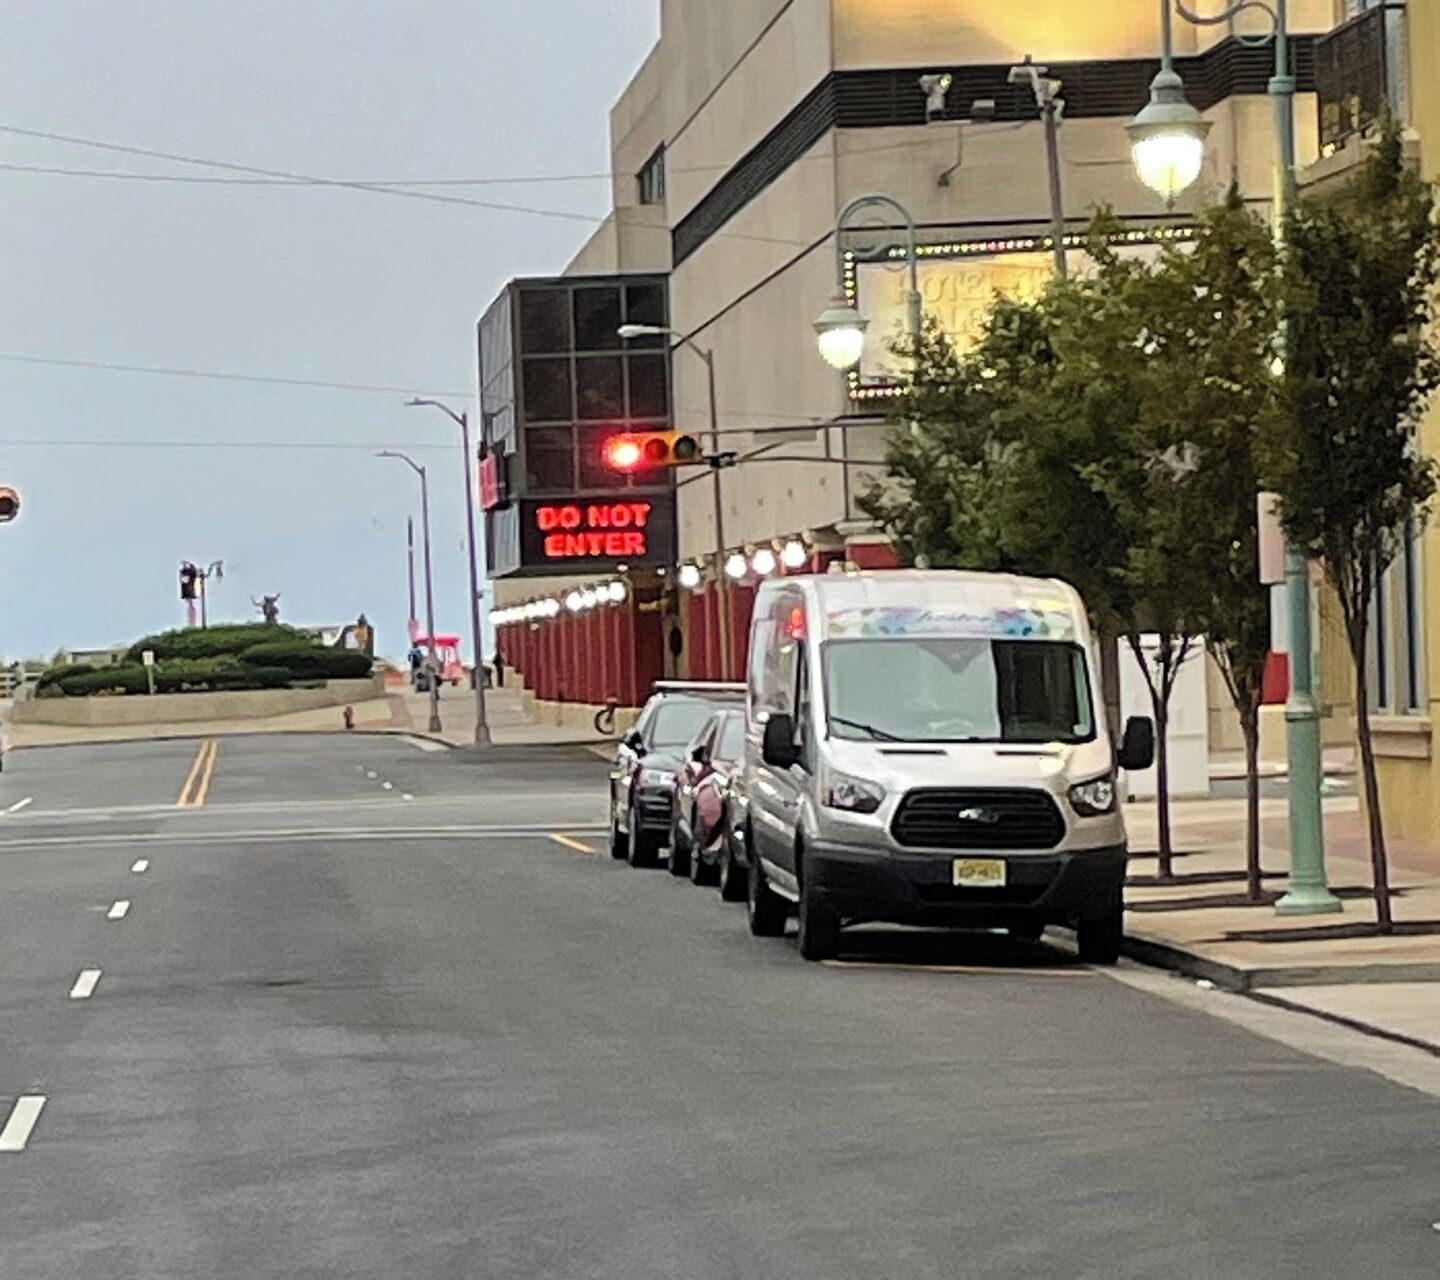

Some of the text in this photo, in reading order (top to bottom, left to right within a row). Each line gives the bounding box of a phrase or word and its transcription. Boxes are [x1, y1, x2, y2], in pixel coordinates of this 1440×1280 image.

[536, 504, 651, 530] DO NOT
[544, 532, 646, 556] ENTER
